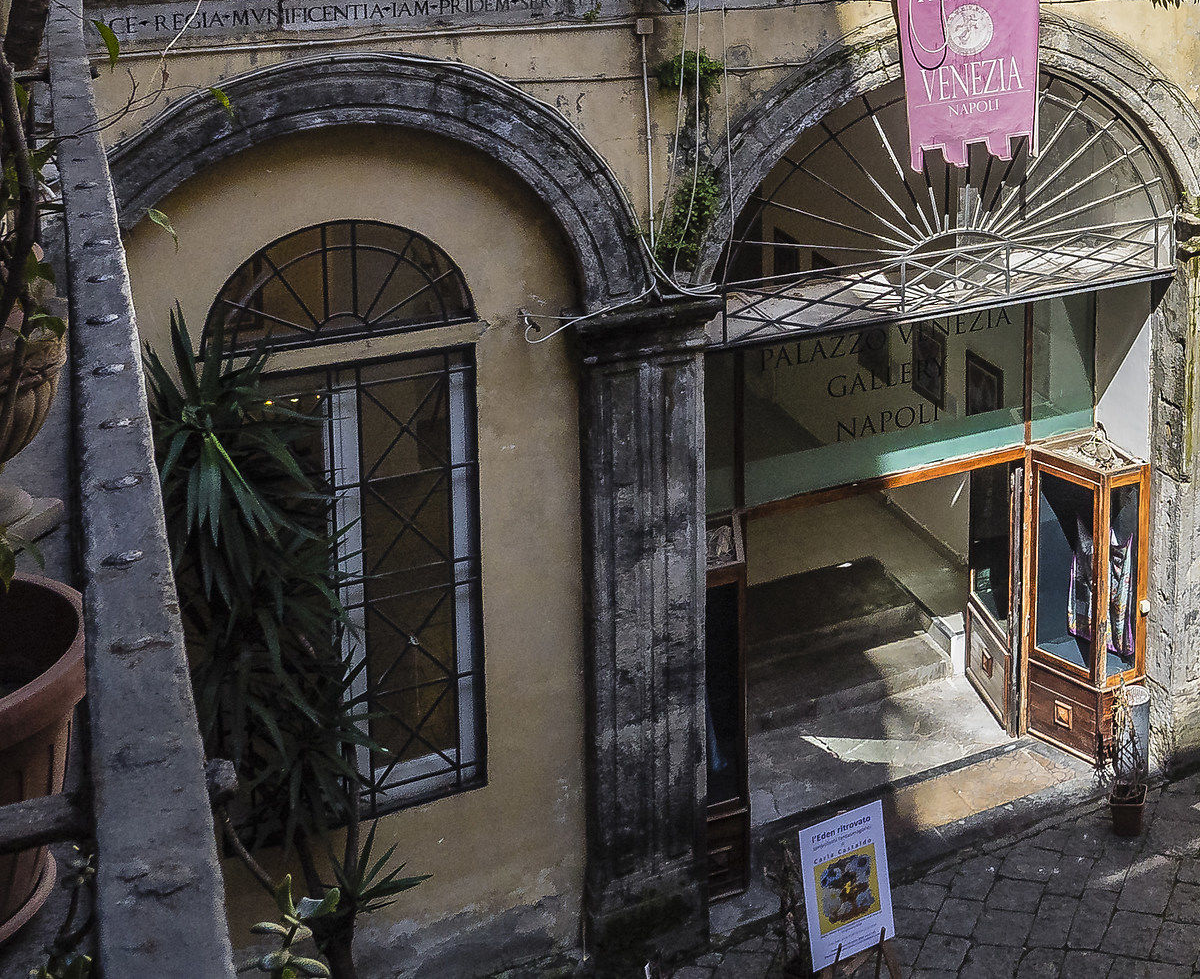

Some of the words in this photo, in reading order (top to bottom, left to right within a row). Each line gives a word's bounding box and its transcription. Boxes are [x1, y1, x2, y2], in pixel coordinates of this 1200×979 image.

[154, 11, 224, 32] REGIA
[392, 0, 430, 18] IAM
[920, 56, 1024, 102] VENEZIA
[948, 99, 1000, 117] NAPOLI
[760, 327, 887, 372] PALAZZO
[827, 355, 948, 398] GALLERY
[837, 402, 939, 442] NAPOLI
[837, 816, 871, 833] ritrovato
